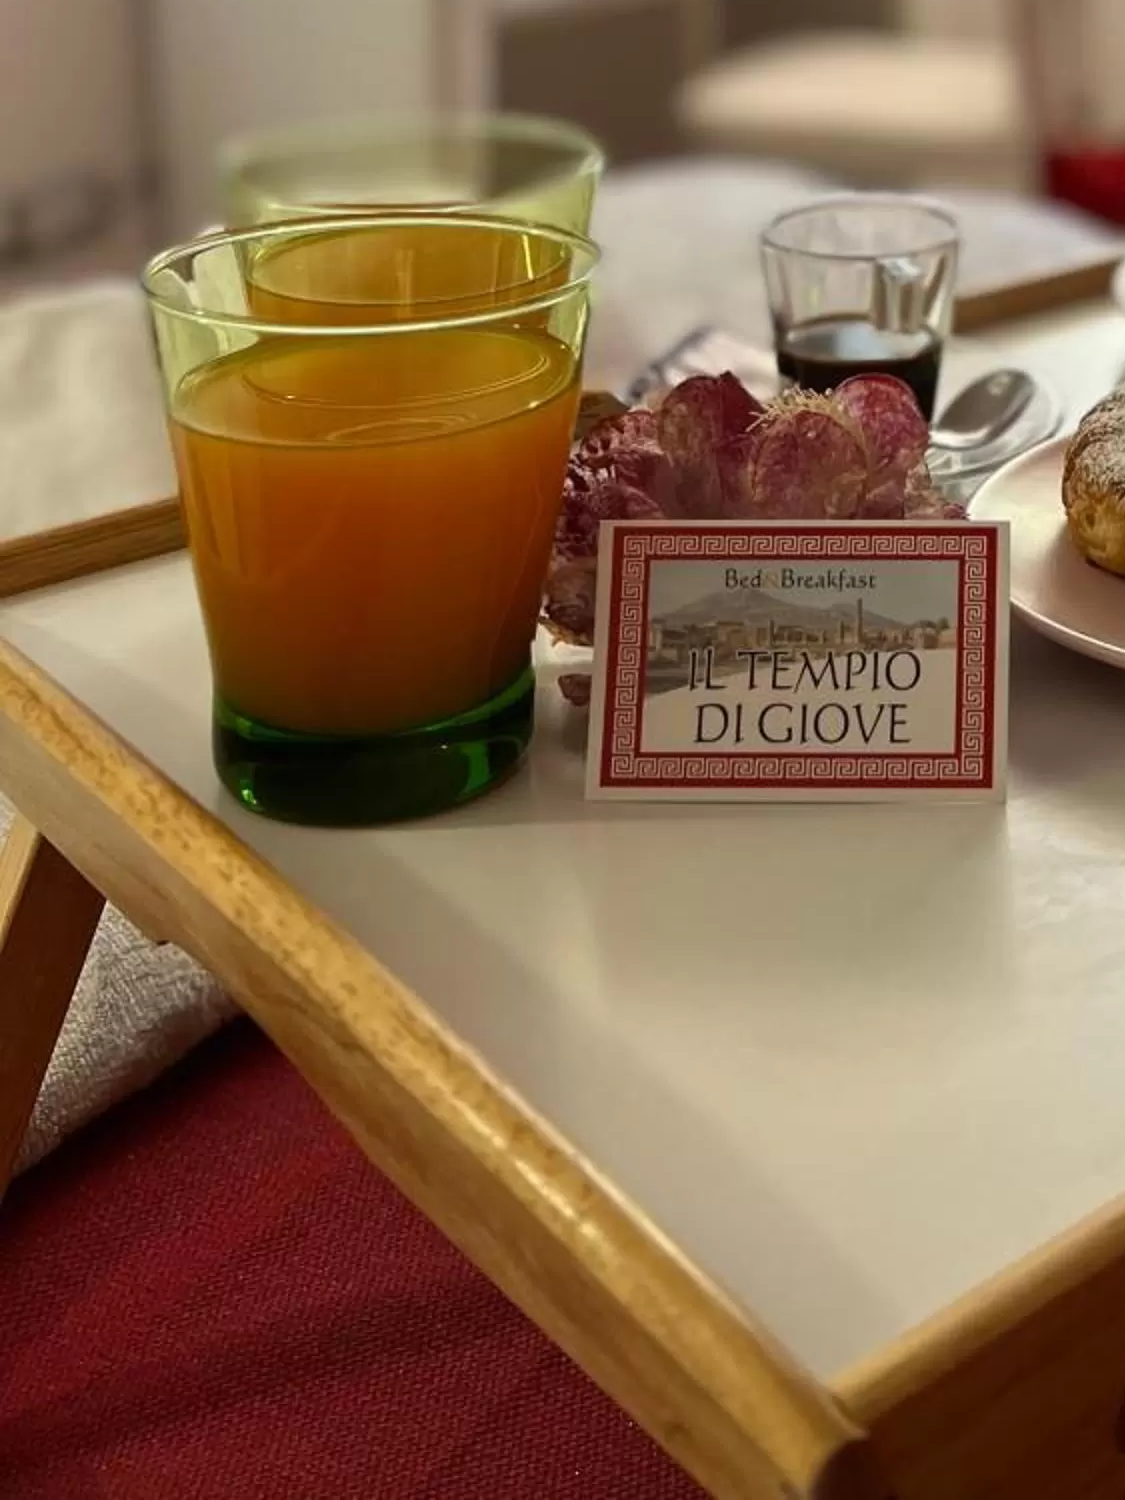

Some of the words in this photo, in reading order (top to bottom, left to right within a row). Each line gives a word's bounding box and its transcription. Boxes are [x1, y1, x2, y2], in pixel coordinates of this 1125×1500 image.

[689, 649, 726, 691] IL
[737, 649, 922, 693] TEMPIO
[694, 702, 744, 745] DI
[758, 702, 912, 745] GIOVE
